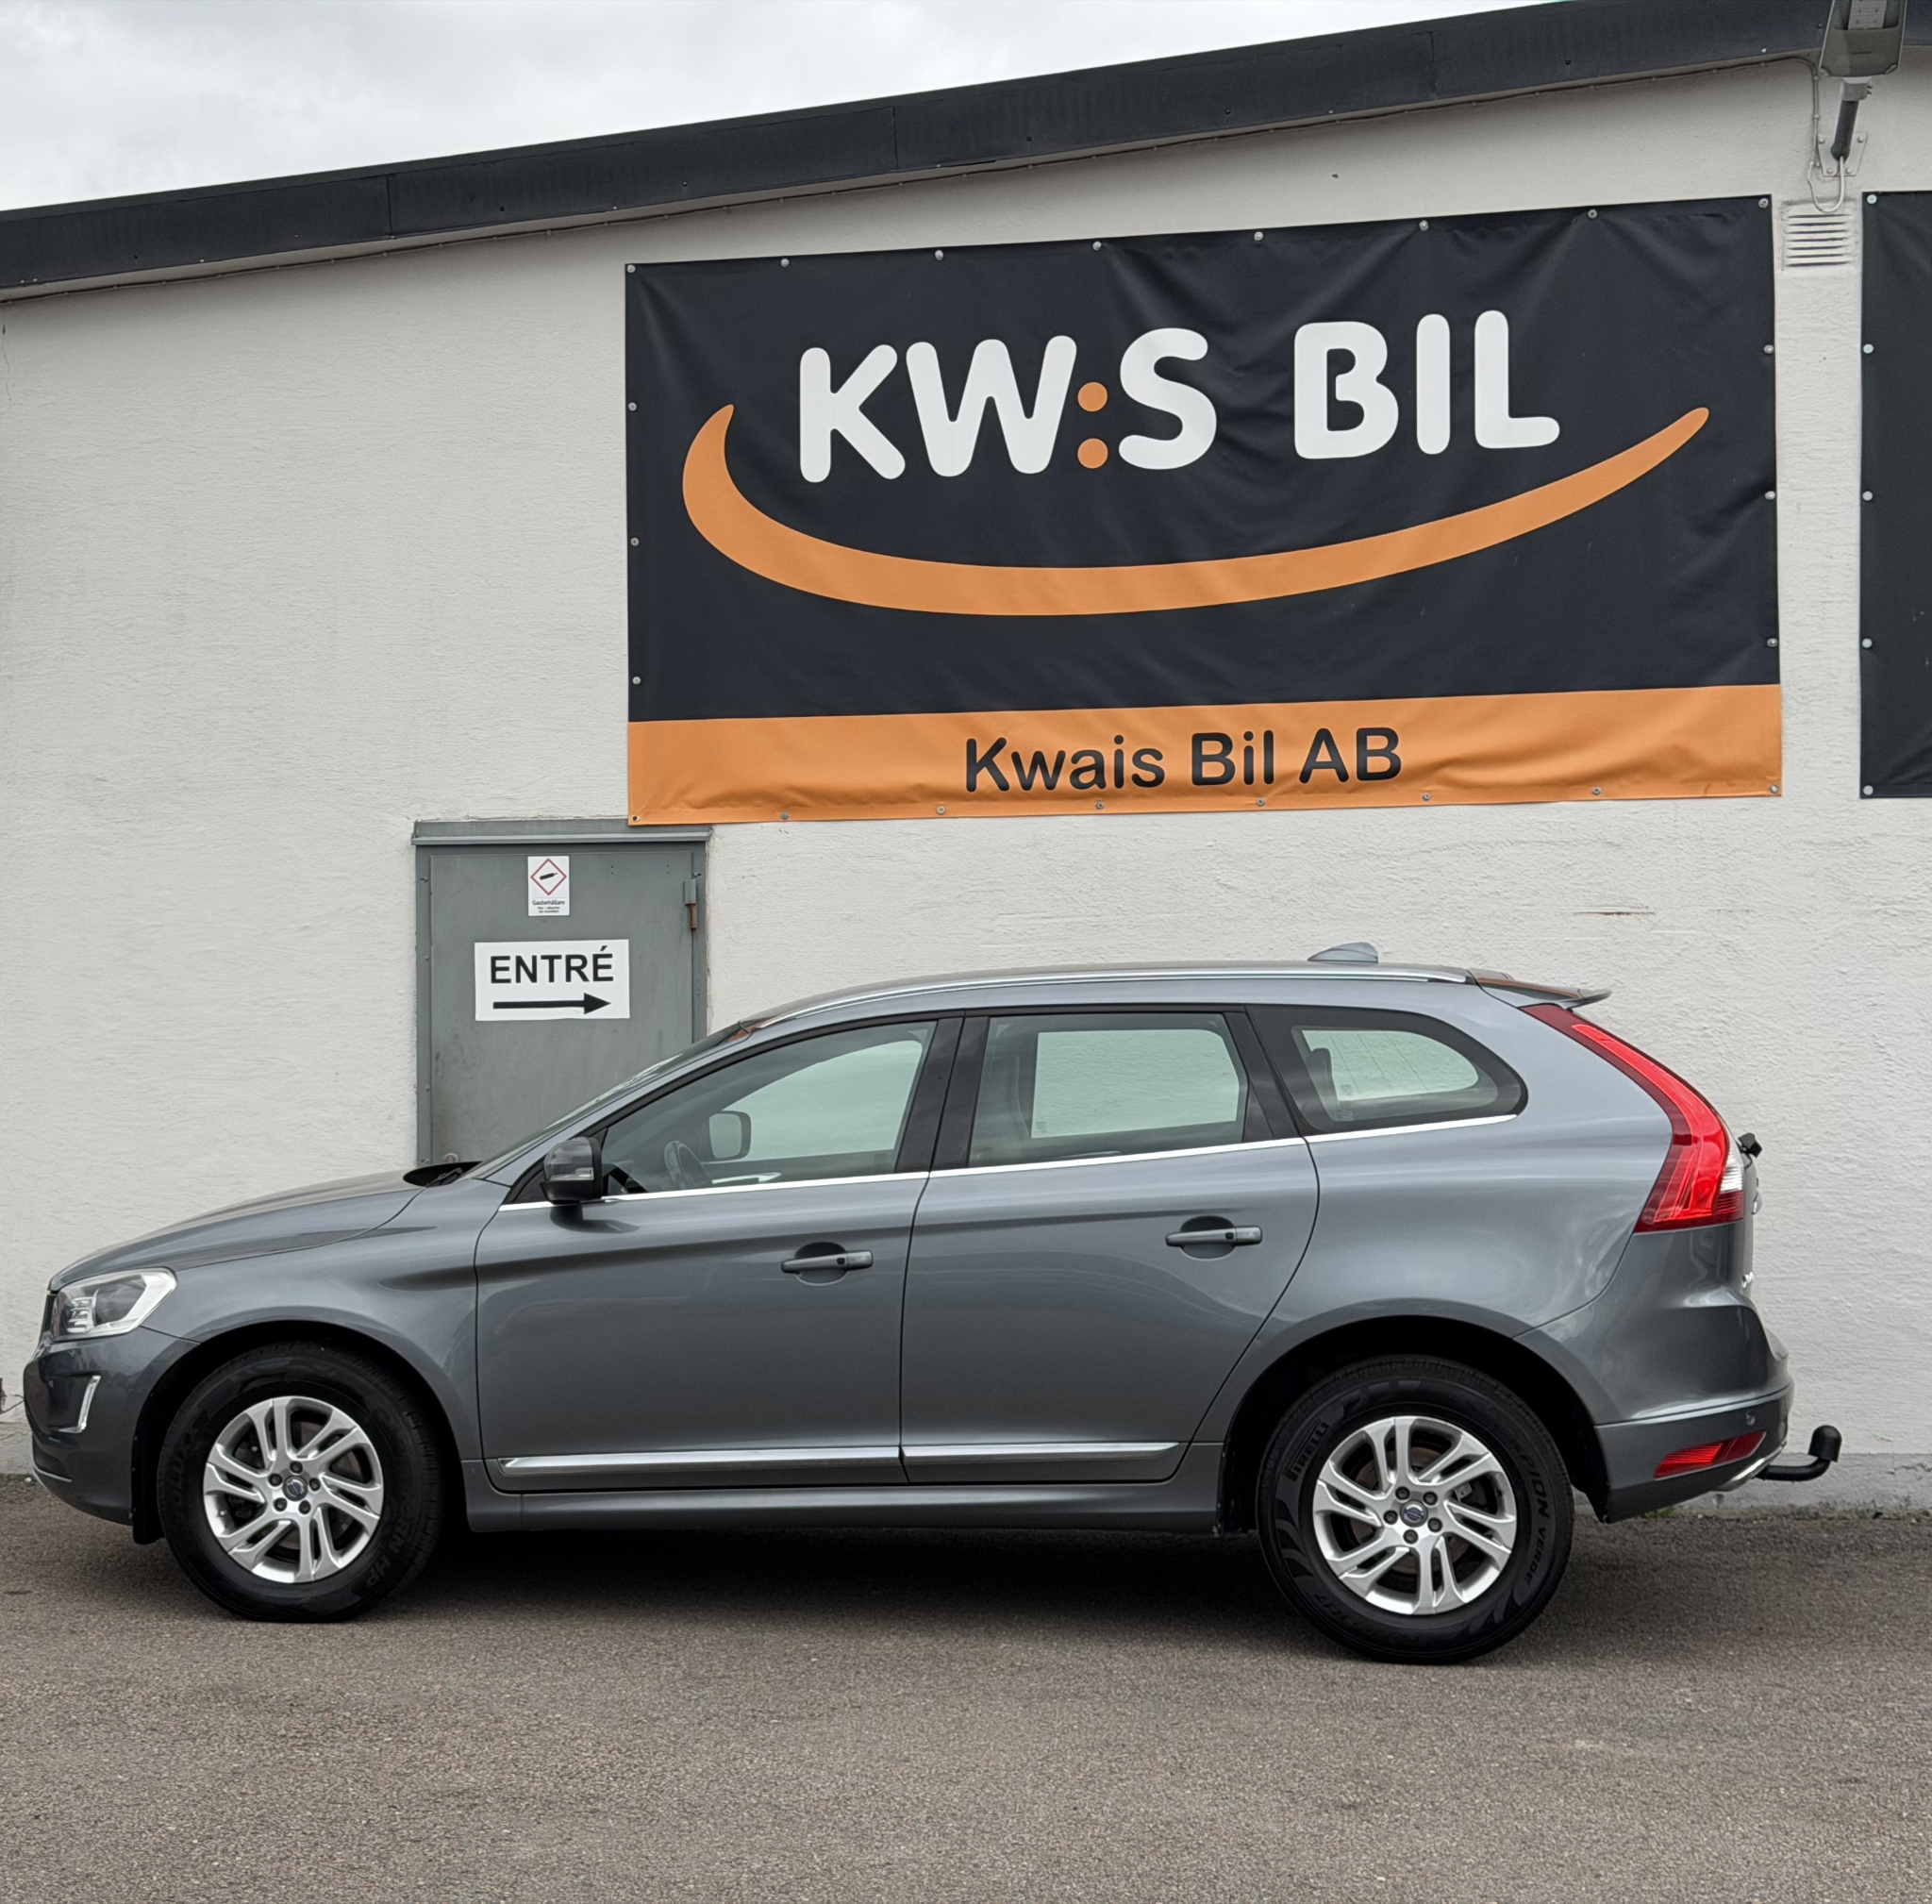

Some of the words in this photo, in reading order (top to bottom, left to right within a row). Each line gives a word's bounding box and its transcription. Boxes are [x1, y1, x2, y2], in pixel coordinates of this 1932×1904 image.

[799, 327, 1217, 483] KW:S
[1293, 309, 1560, 459] BIL
[966, 734, 1165, 793] Kwais
[1191, 729, 1274, 787] Bil
[1298, 727, 1402, 784] AB
[490, 944, 614, 984] ENTRÉ
